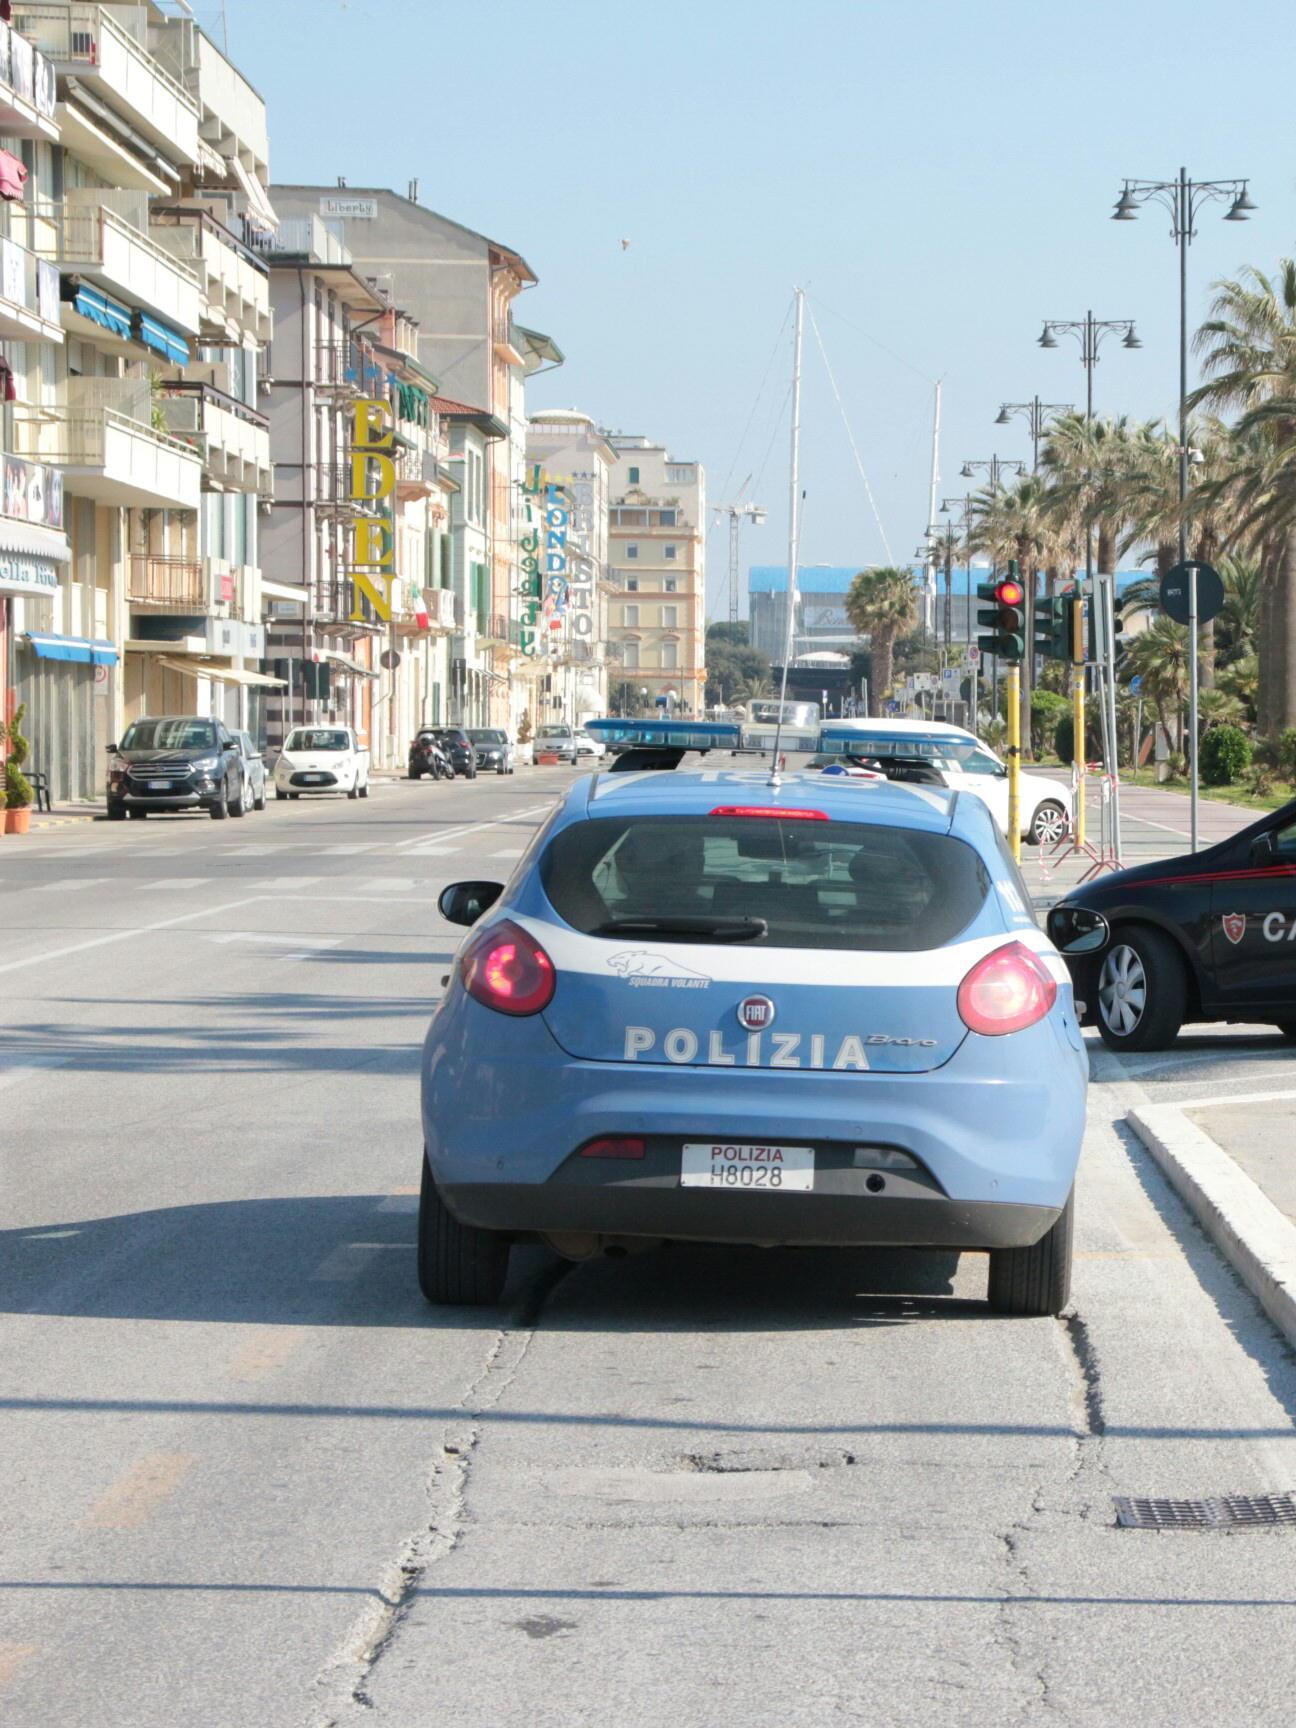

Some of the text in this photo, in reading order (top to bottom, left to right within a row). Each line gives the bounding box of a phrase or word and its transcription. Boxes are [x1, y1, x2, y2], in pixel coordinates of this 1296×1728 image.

[327, 199, 374, 215] Liberty
[349, 400, 396, 622] EDEN
[627, 976, 711, 989] SQUADRA VOLANTE
[745, 1004, 767, 1021] FIAT
[623, 1025, 938, 1070] POLIZIA Bravo
[711, 1146, 784, 1163] POLIZIA
[711, 1164, 783, 1188] H8028
